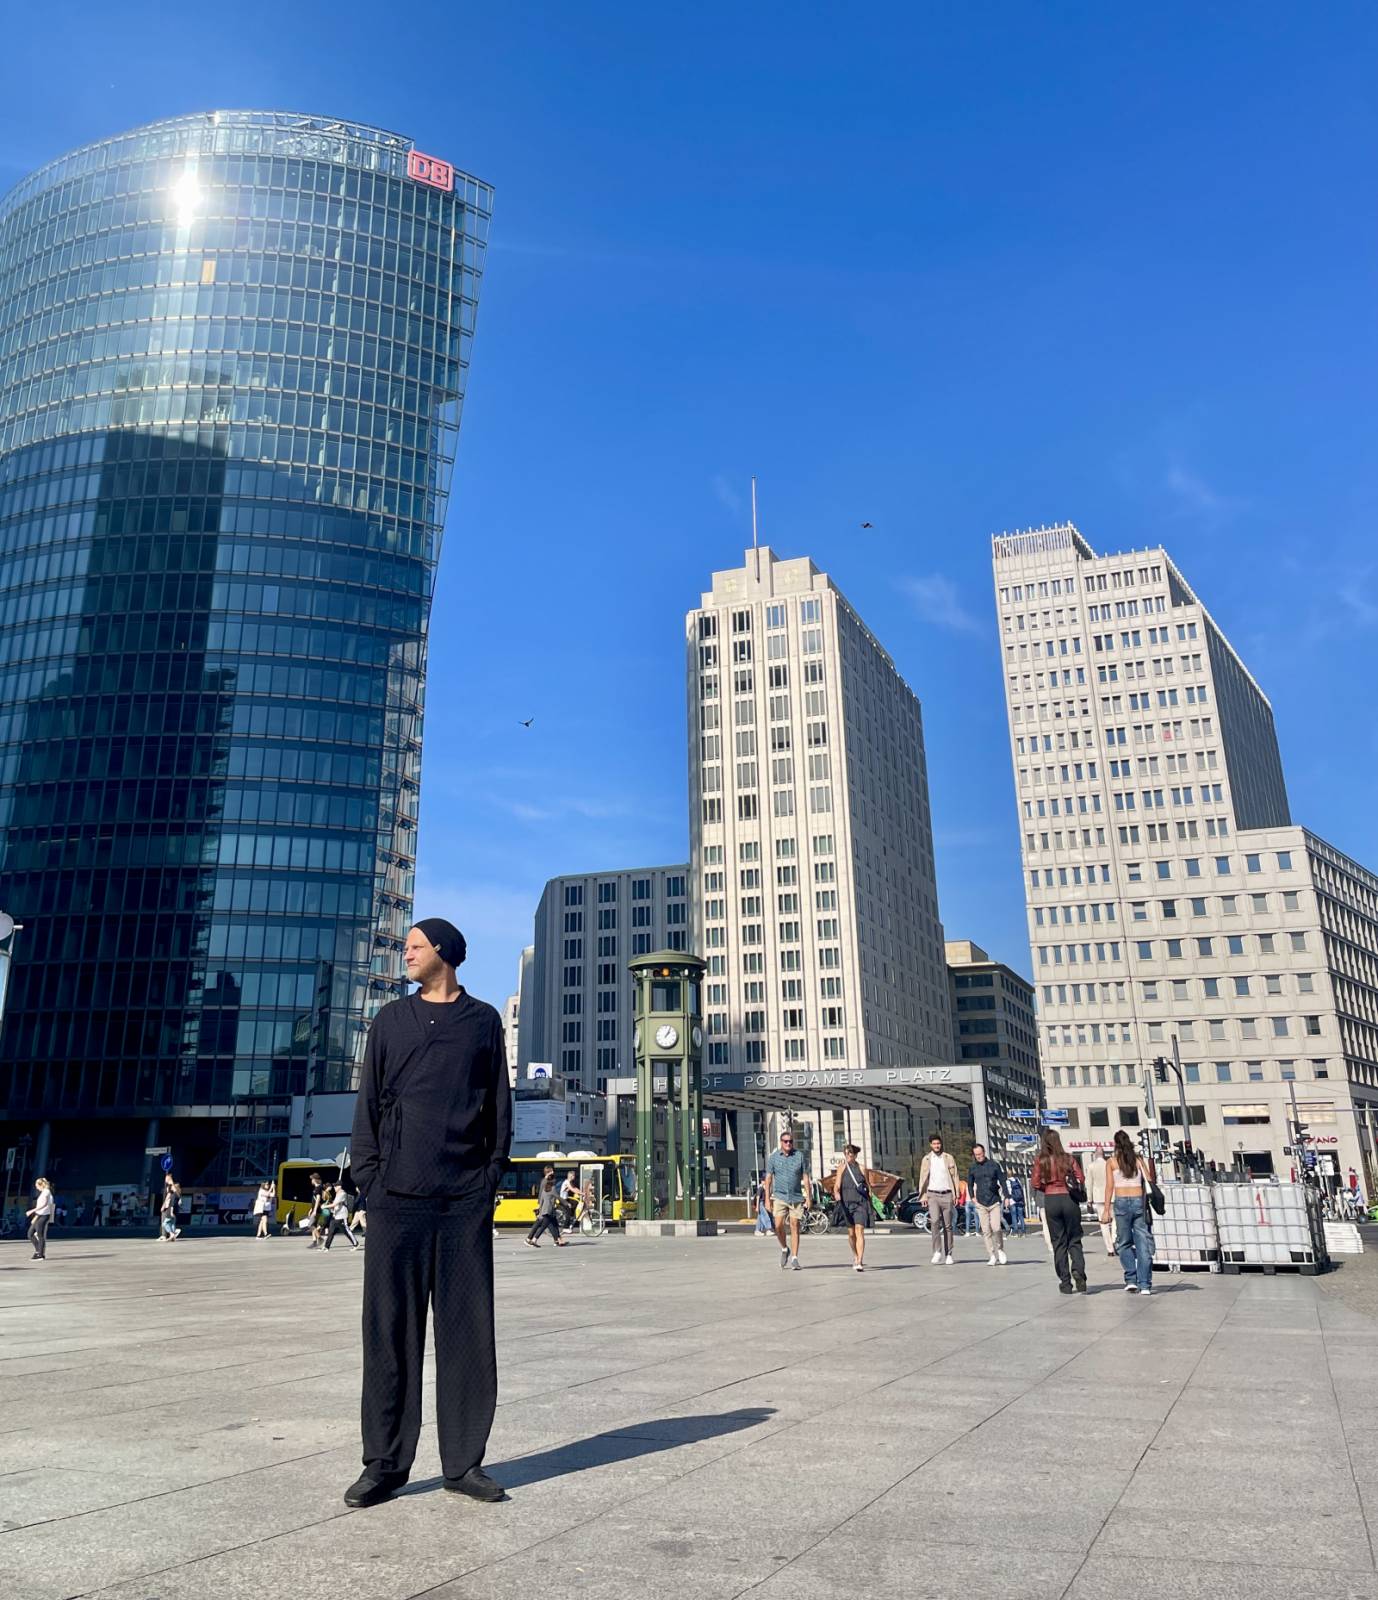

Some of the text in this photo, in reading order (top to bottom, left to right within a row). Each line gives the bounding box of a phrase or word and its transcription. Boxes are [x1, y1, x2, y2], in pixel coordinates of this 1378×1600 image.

[413, 156, 448, 186] DB
[632, 1069, 952, 1091] BHNOF POTSDAMER PLATZ
